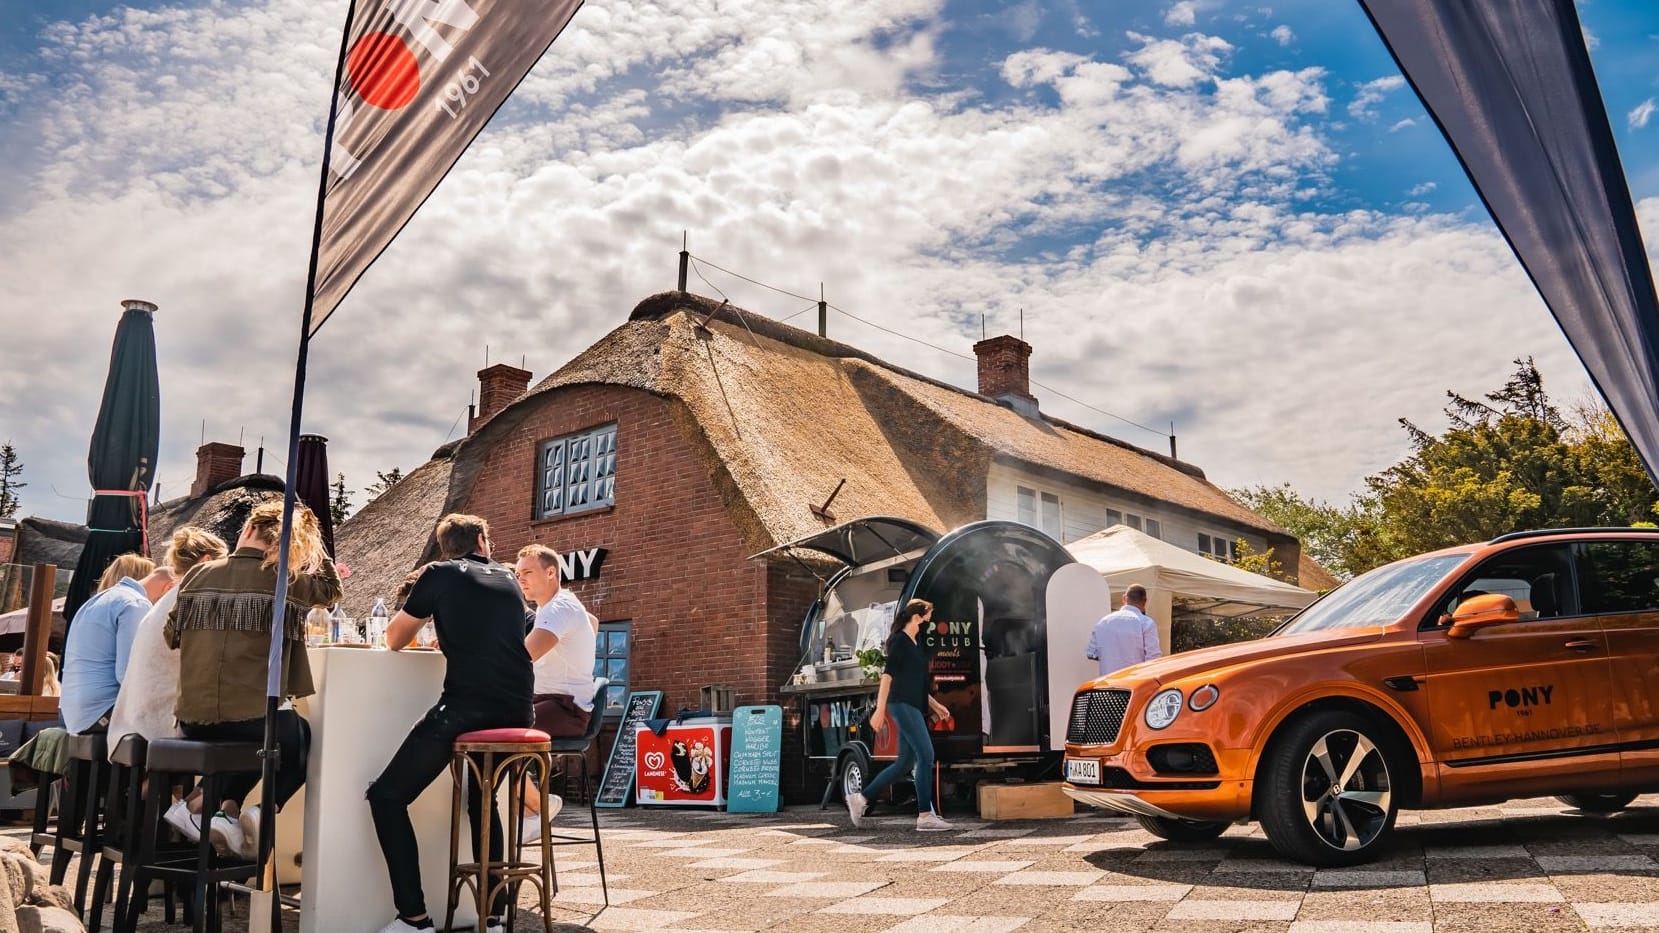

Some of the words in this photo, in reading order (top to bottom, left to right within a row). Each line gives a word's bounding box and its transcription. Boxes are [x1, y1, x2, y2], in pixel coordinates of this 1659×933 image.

[434, 55, 491, 120] 1961
[926, 621, 972, 636] PONY
[926, 636, 972, 647] CLUB
[1488, 684, 1554, 710] PONY
[810, 700, 851, 729] PONY
[1516, 709, 1533, 717] 1961
[1083, 762, 1096, 778] 801
